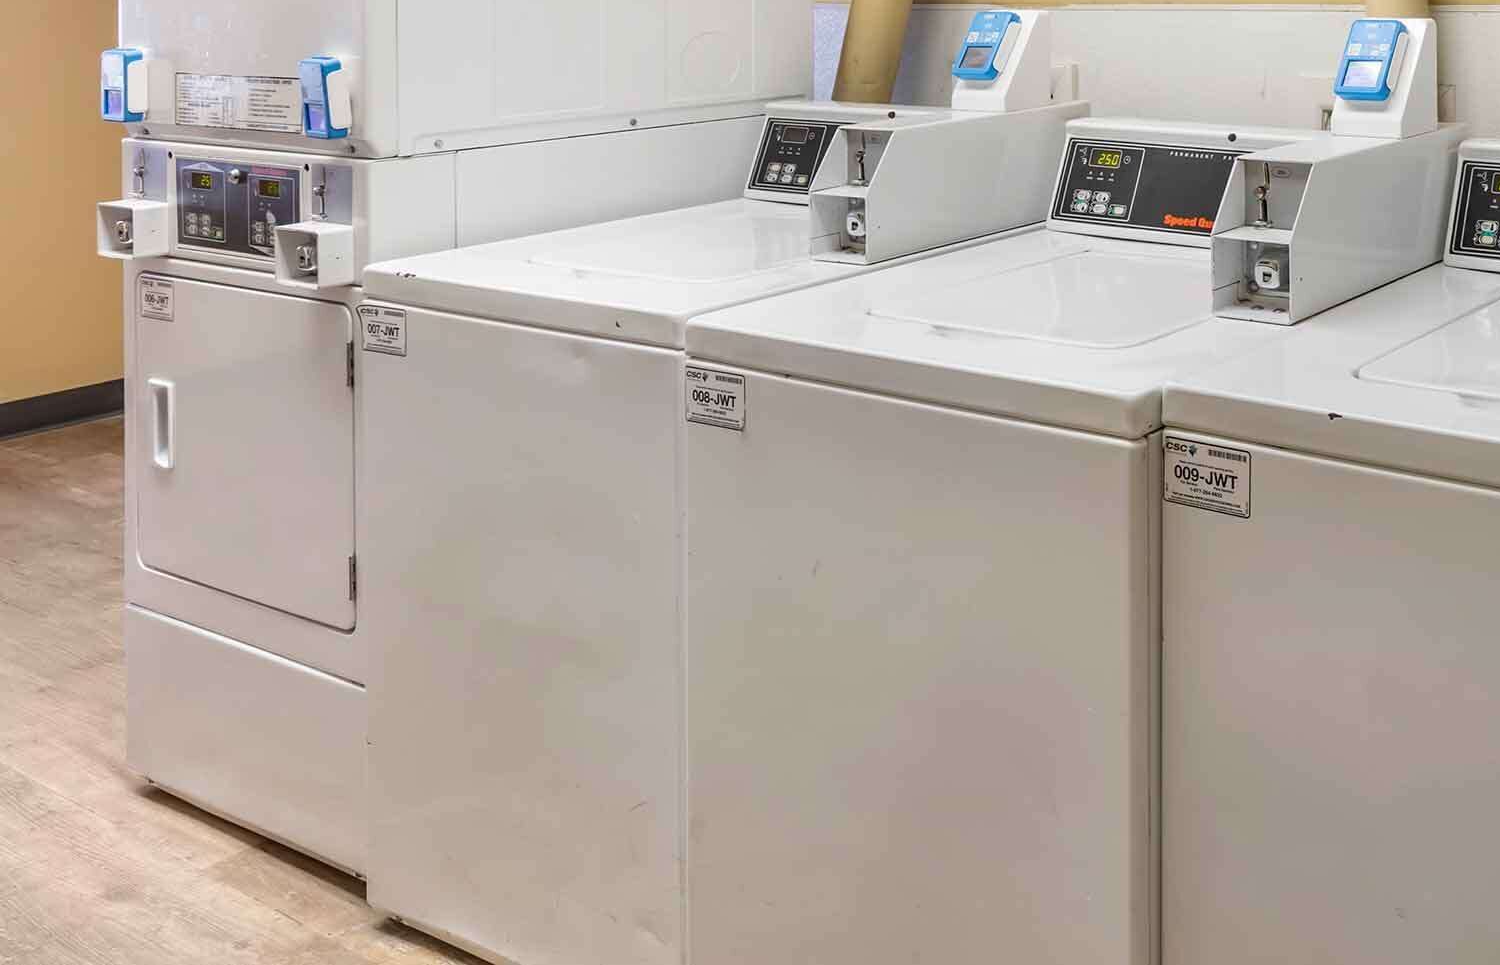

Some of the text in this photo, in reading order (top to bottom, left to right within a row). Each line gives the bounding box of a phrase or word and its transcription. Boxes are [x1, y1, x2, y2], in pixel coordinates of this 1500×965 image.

[1097, 153, 1120, 166] 250
[1163, 214, 1198, 228] Speed
[367, 323, 400, 337] 007-JWT
[692, 389, 737, 408] 008-JWT
[1166, 442, 1188, 453] CSC
[1174, 464, 1239, 490] 009-JWT
